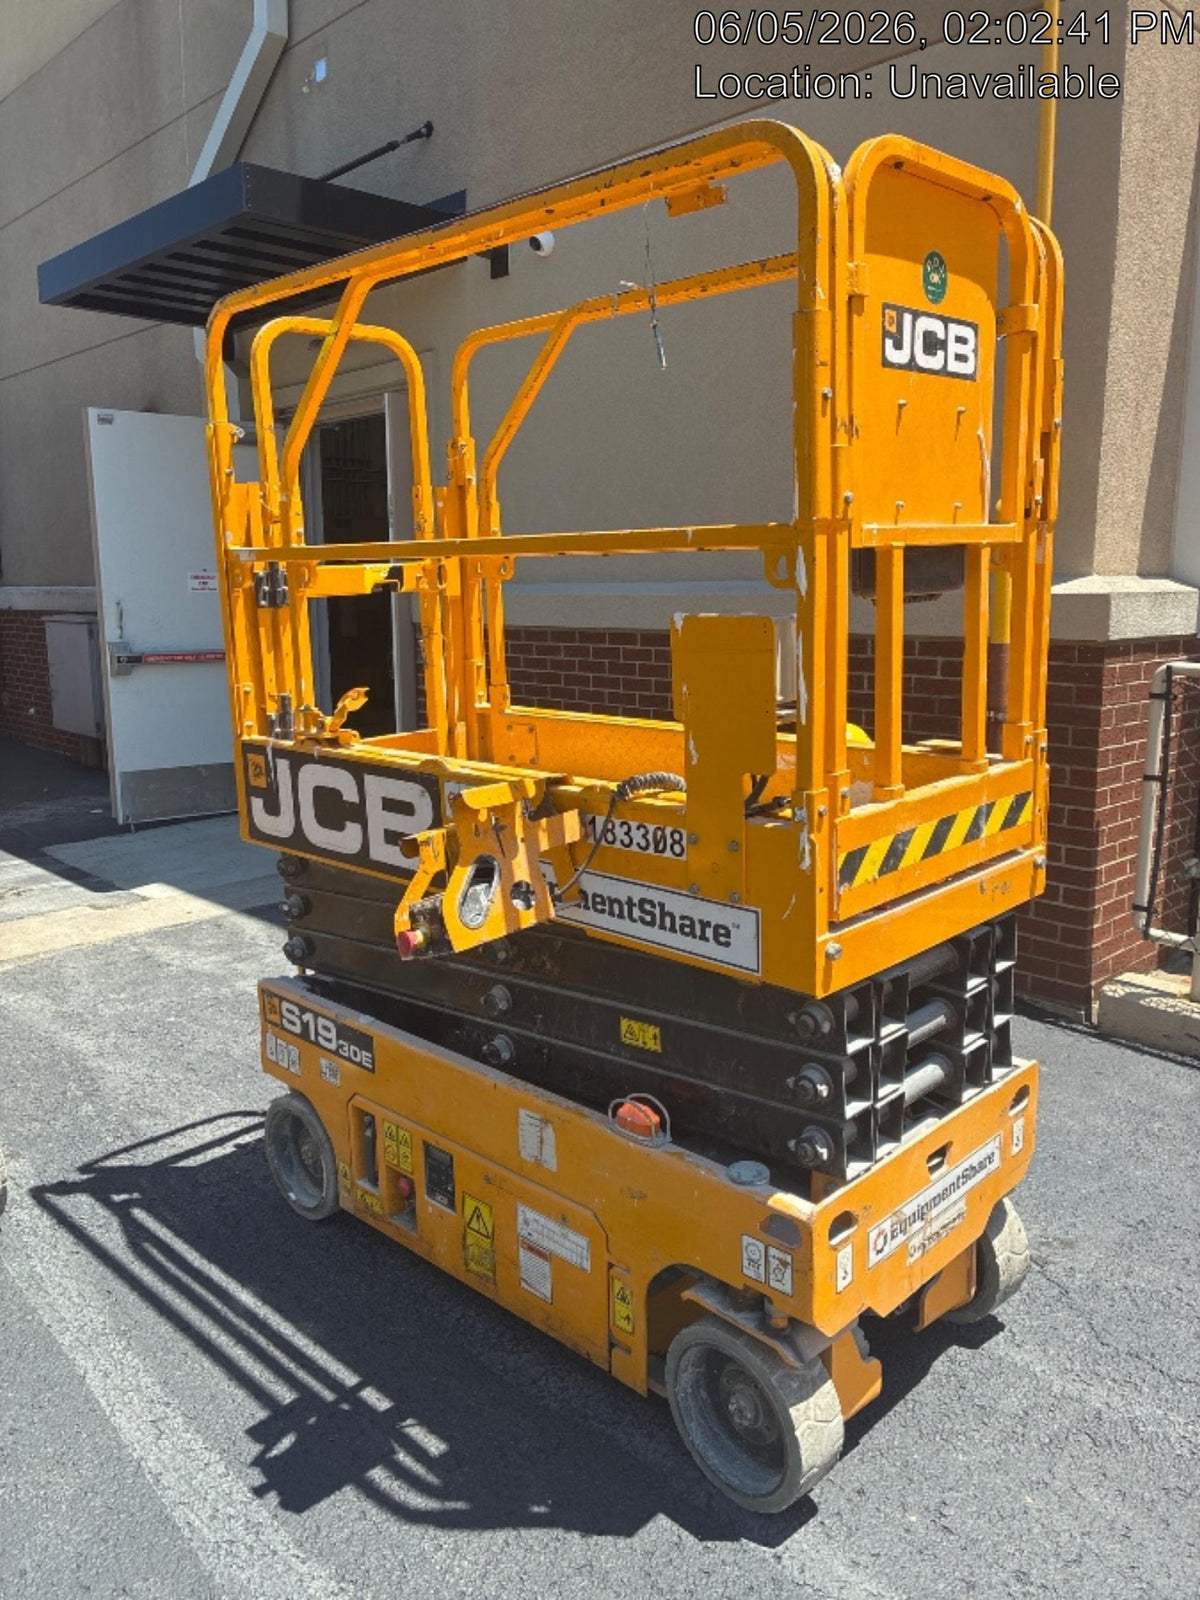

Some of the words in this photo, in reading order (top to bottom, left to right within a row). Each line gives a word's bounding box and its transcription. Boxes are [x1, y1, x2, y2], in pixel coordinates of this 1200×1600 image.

[884, 312, 977, 375] JCB
[250, 757, 435, 872] JCB
[587, 815, 686, 858] 183308
[889, 1150, 996, 1243] EquipmentShare
